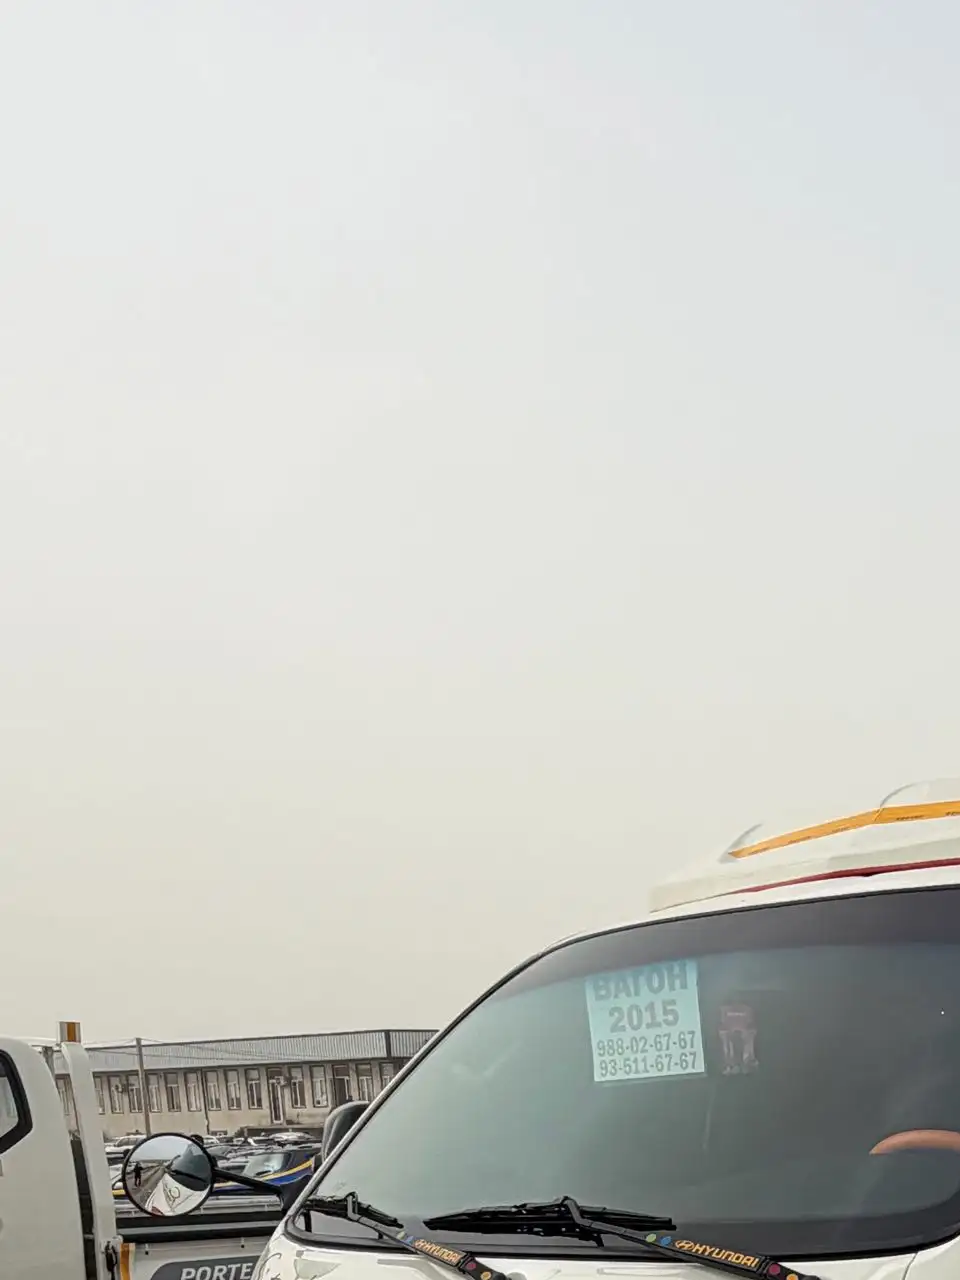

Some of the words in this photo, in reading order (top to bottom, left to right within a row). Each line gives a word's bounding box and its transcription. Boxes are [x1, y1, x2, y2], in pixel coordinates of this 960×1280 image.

[607, 999, 680, 1033] 2015
[596, 1030, 697, 1057] 988-02-67-67
[599, 1051, 698, 1078] 93-511-67-67
[426, 1241, 462, 1263] HYUNDAI
[691, 1243, 760, 1268] HYUNDAI
